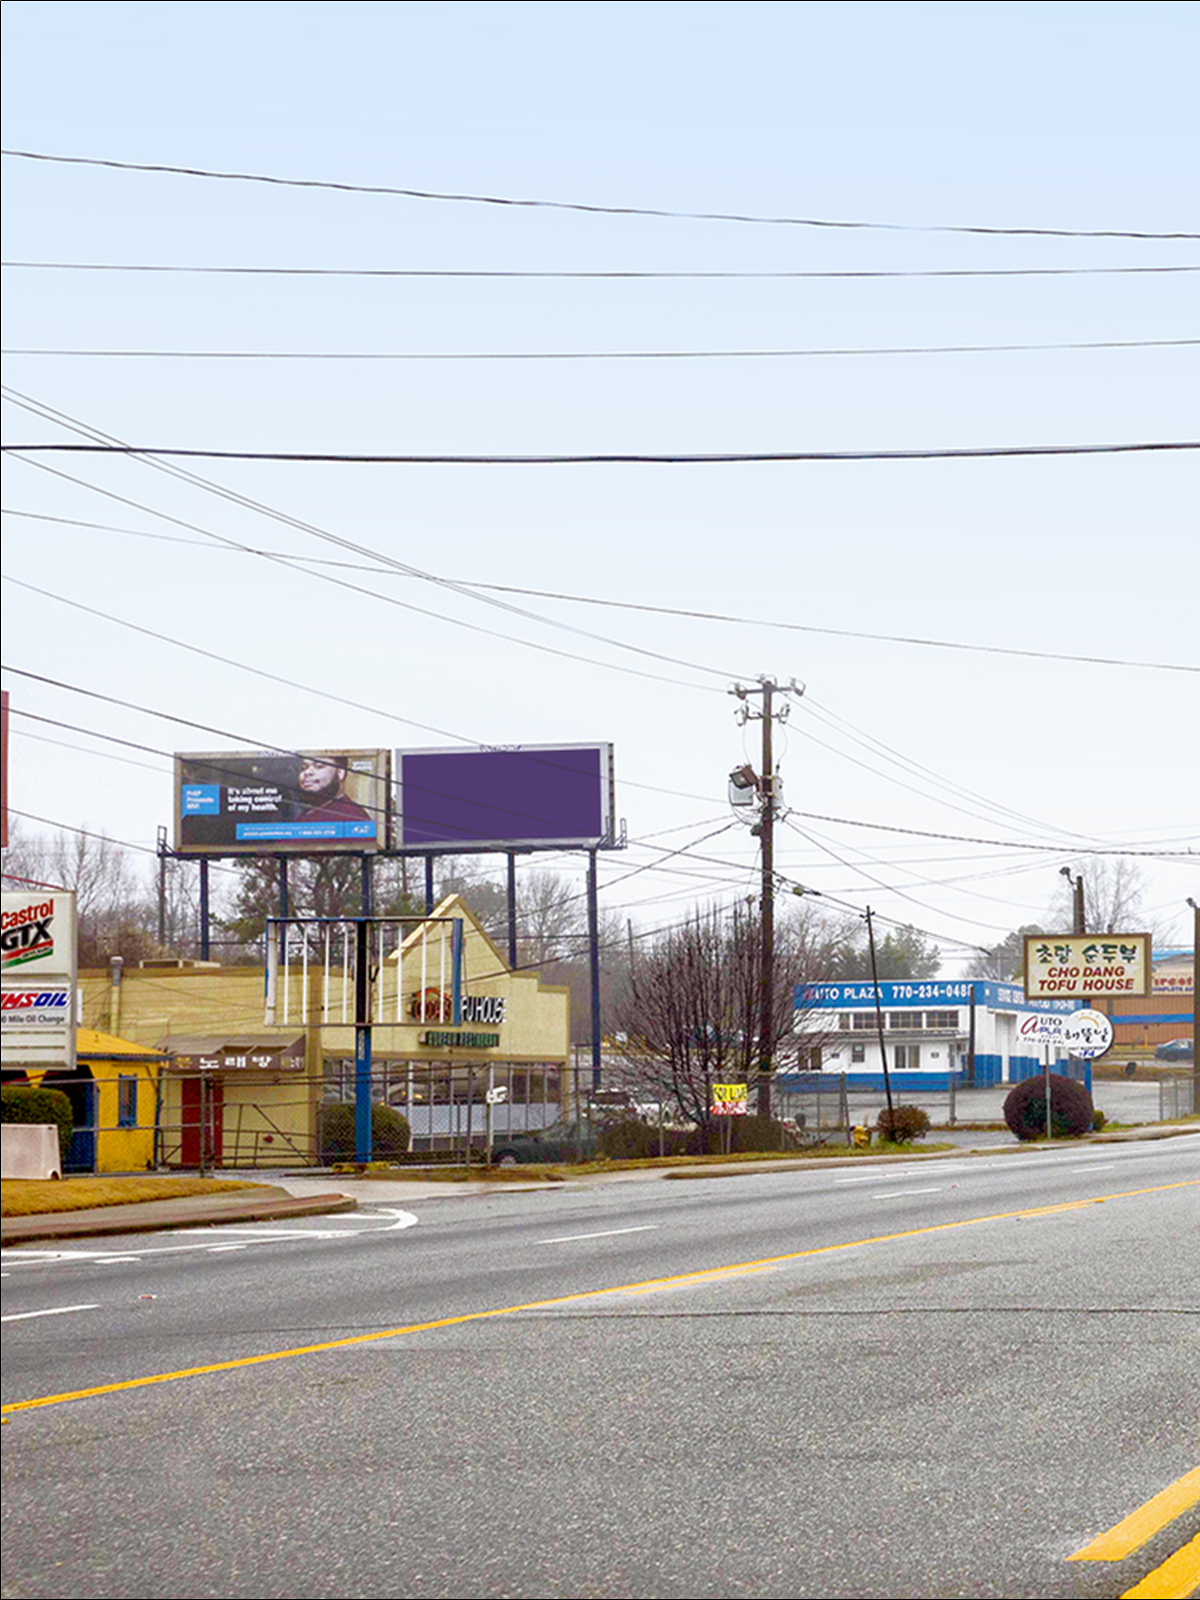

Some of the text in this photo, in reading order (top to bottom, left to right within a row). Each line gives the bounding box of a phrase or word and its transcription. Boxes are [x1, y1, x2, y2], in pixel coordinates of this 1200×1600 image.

[228, 795, 282, 804] taking control
[1, 898, 54, 930] Castrol
[1, 917, 54, 951] GTX
[1036, 944, 1137, 964] 초당 순두부
[1047, 966, 1125, 978] CHO DANG
[1038, 978, 1135, 991] TOFU HOUSE
[843, 985, 884, 999] PLAZA
[9, 1015, 24, 1023] Mile
[26, 1015, 36, 1023] Oil
[38, 1014, 65, 1025] Change
[1039, 1026, 1062, 1035] PLA
[199, 1055, 273, 1069] 노래방
